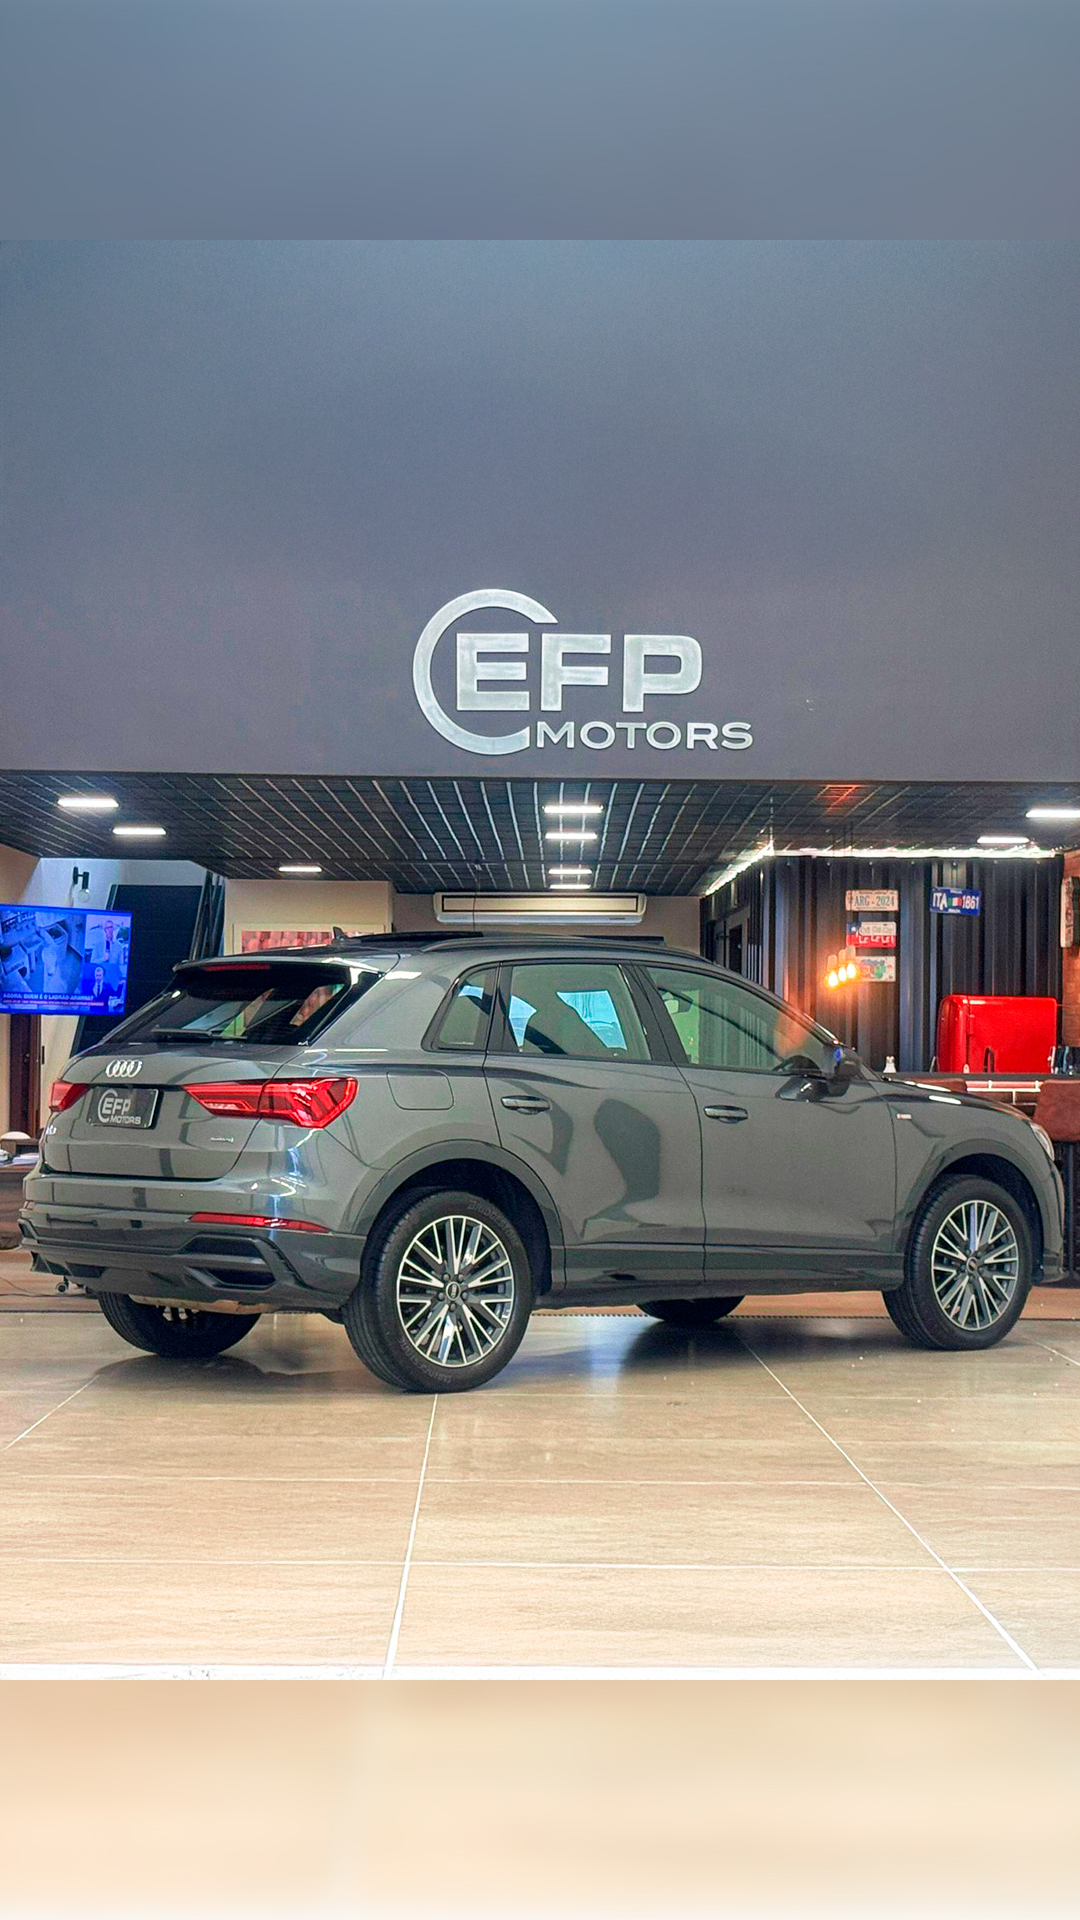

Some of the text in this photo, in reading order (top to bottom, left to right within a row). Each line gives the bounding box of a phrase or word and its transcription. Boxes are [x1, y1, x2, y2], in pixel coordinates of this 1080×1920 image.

[536, 720, 754, 750] MOTORS
[854, 895, 870, 907] ARG
[932, 893, 979, 910] ITA 1861
[110, 1114, 141, 1125] MOTORS
